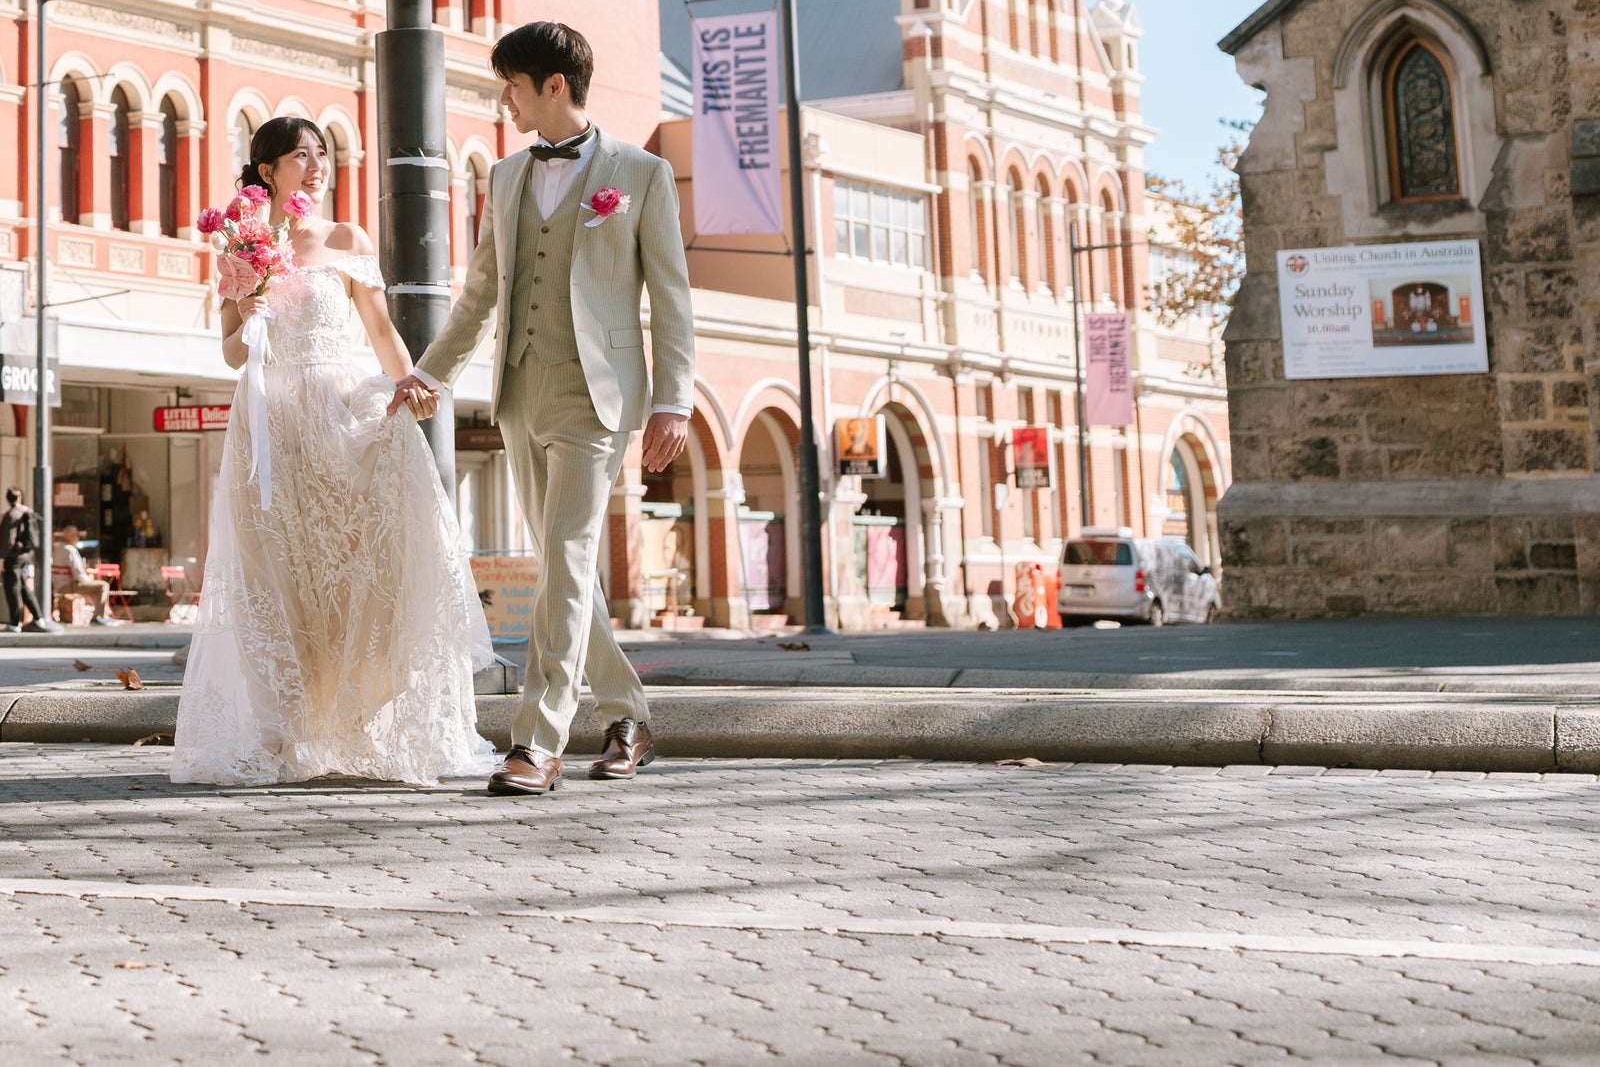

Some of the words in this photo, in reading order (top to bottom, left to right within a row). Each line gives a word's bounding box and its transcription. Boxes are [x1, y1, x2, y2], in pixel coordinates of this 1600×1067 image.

[701, 26, 731, 52] IS
[702, 59, 732, 115] THIS
[734, 23, 770, 170] FREMANTLE
[1314, 252, 1357, 265] Uniting
[1360, 249, 1402, 262] Church
[1405, 246, 1417, 259] in
[1421, 245, 1475, 258] Australia
[1295, 282, 1356, 301] Sunday
[1293, 302, 1363, 320] Worship
[1089, 317, 1107, 331] IS
[1089, 334, 1108, 365] THIS
[1108, 316, 1128, 392] FREMANTLE
[1, 365, 57, 394] GROCR
[164, 408, 198, 420] LITTLE
[164, 419, 200, 430] SISTER
